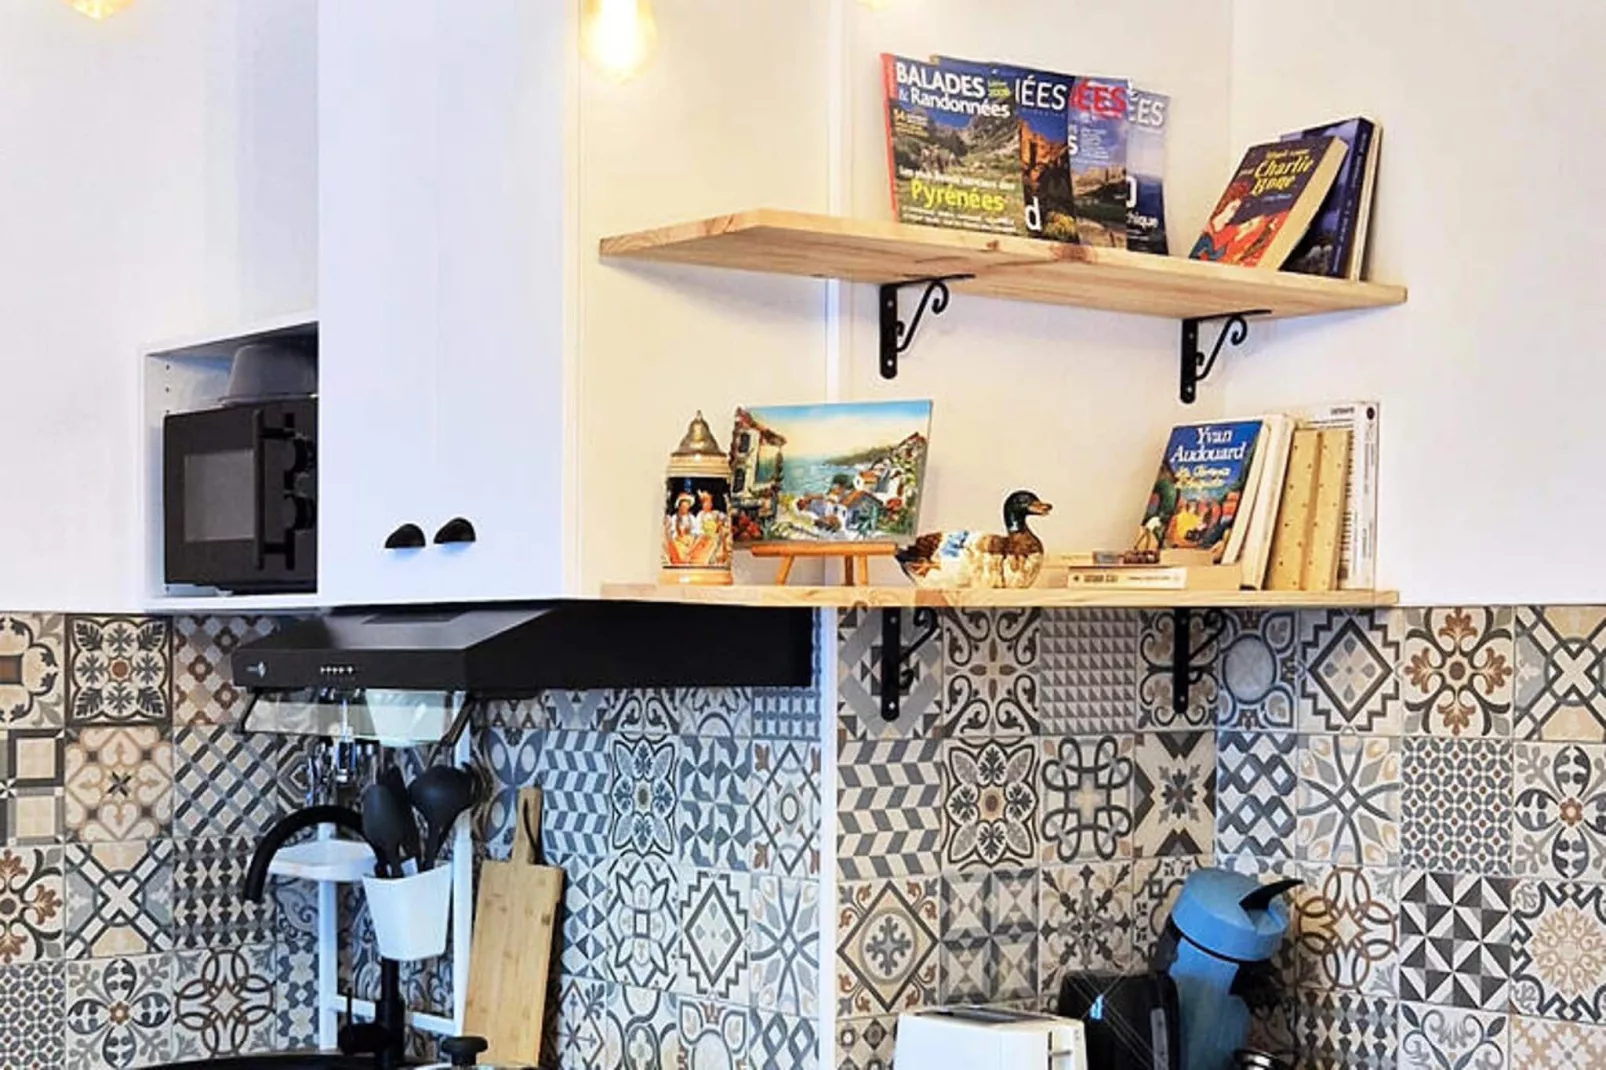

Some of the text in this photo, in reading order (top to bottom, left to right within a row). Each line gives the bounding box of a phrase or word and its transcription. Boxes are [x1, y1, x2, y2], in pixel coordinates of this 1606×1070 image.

[896, 61, 985, 98] BALADES
[899, 85, 1011, 118] & Randonnées
[910, 178, 1005, 212] Pyrénées
[1196, 426, 1233, 444] Yvan
[1169, 441, 1247, 463] Audouard
